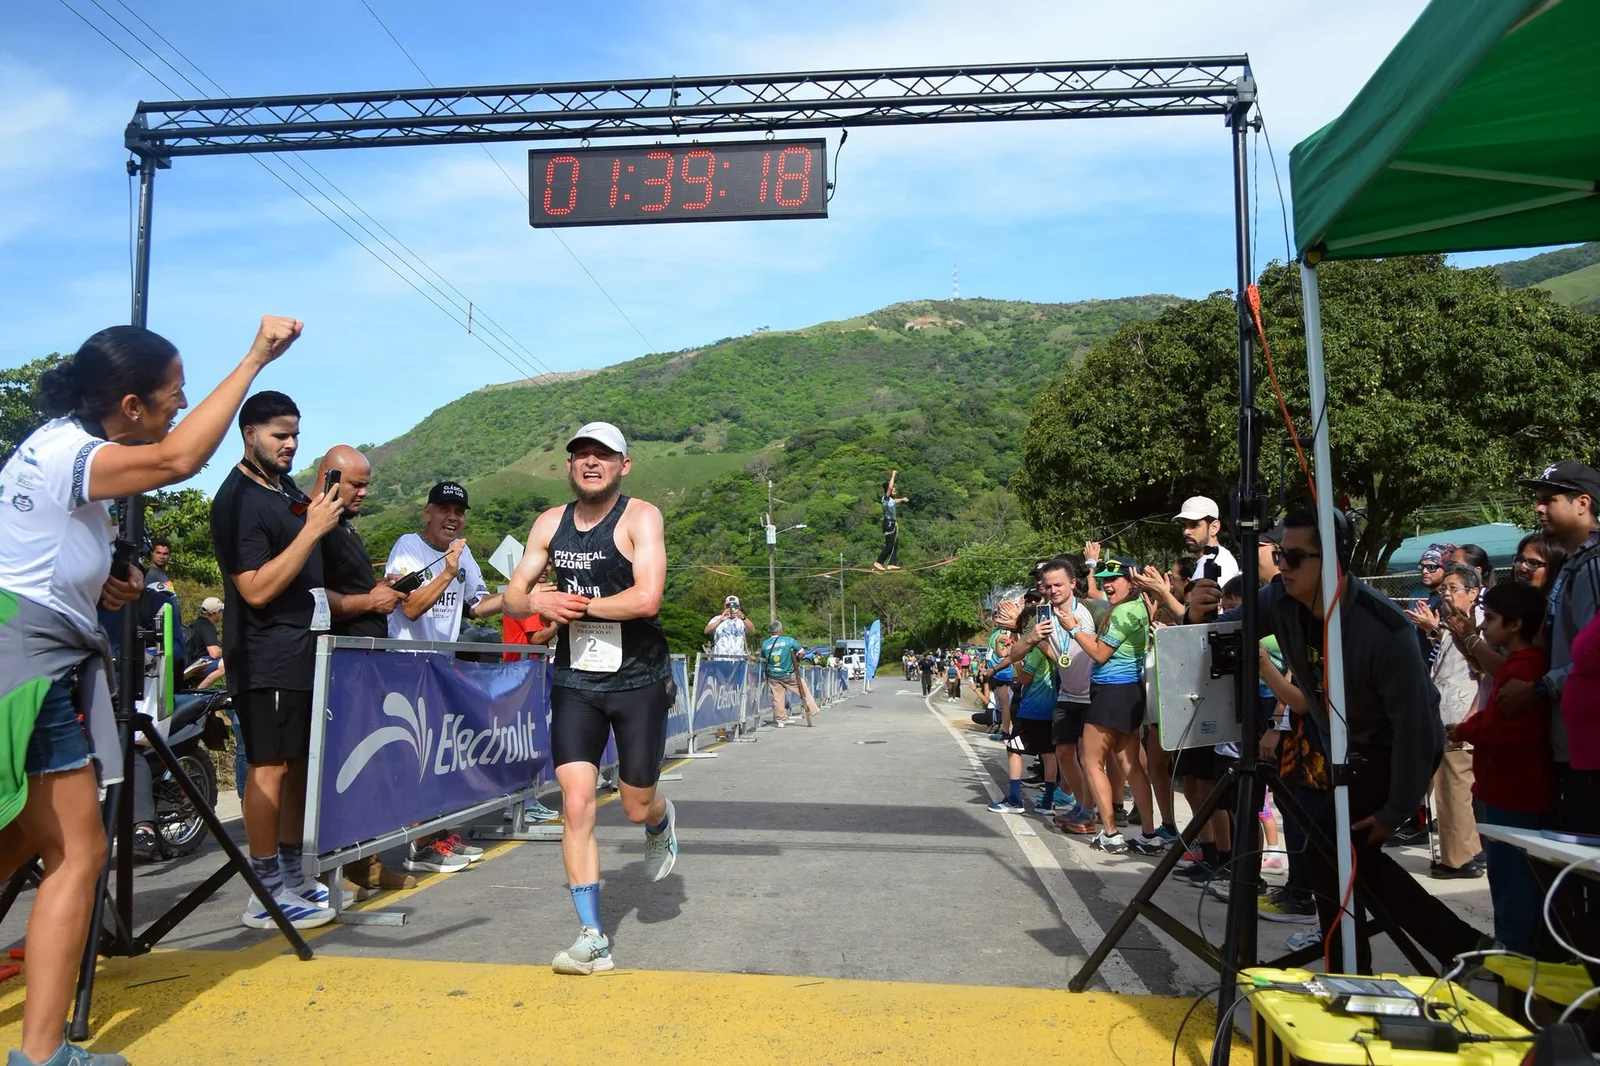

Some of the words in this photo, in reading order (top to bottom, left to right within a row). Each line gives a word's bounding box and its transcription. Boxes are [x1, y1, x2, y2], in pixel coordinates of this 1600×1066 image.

[554, 550, 606, 561] PHYSICAL
[588, 637, 597, 652] 2
[433, 711, 540, 775] Electrolit
